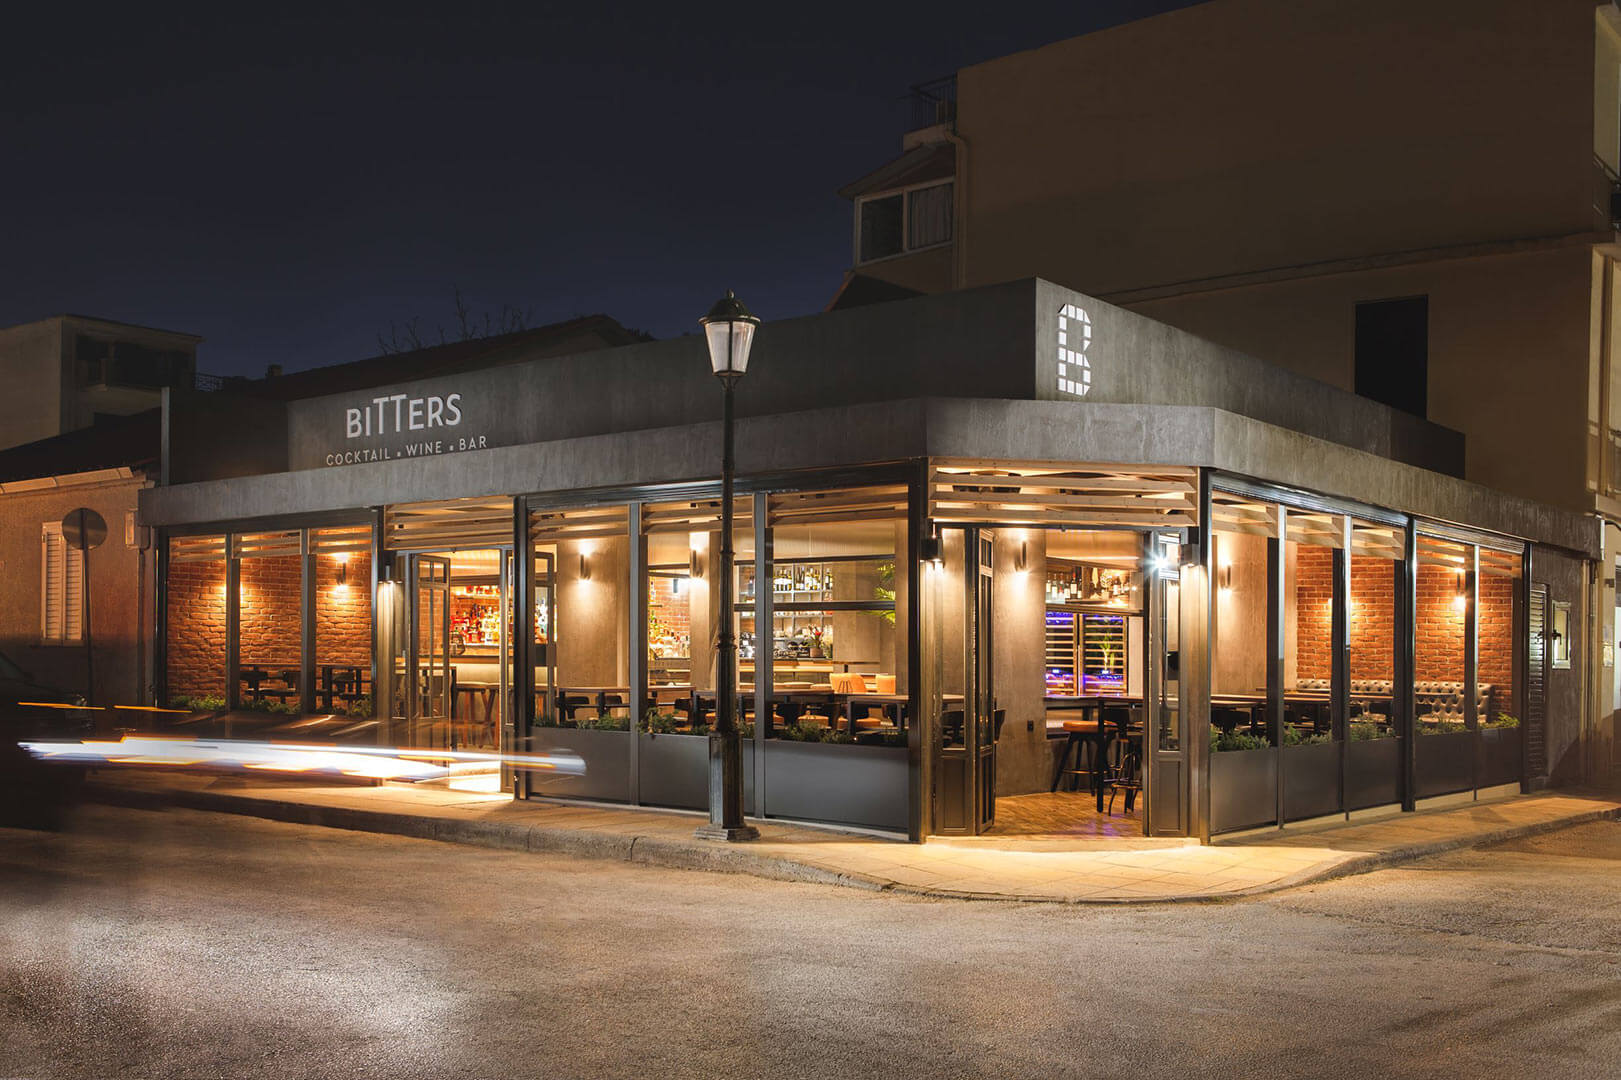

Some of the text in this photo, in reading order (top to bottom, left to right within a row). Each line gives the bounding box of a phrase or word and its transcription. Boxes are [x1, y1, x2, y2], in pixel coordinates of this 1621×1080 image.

[1058, 303, 1092, 396] B
[346, 393, 462, 439] BITTERS
[326, 435, 487, 466] COCKTAIL WINE BAR
